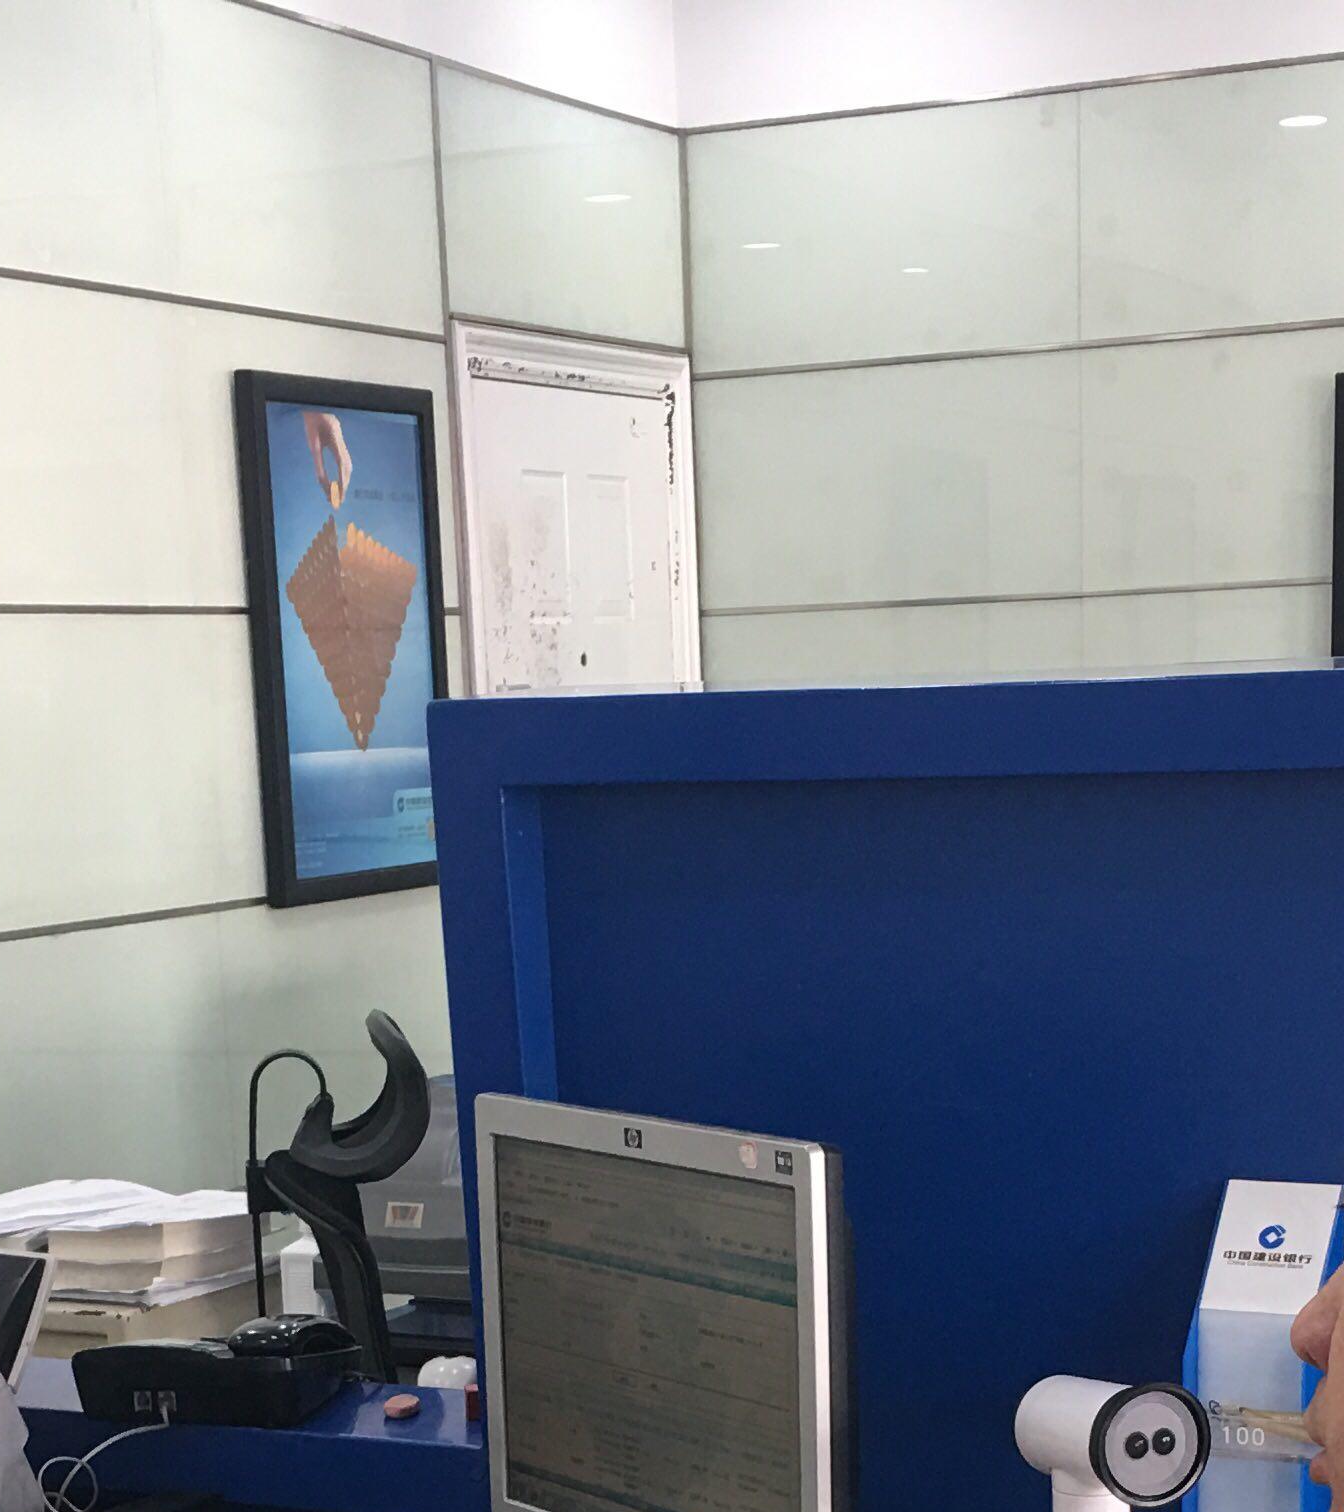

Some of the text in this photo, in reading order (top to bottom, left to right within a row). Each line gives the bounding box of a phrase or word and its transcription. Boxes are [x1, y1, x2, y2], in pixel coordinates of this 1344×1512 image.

[1223, 1250, 1313, 1264] 中国建设银行
[1222, 1425, 1265, 1446] 100
